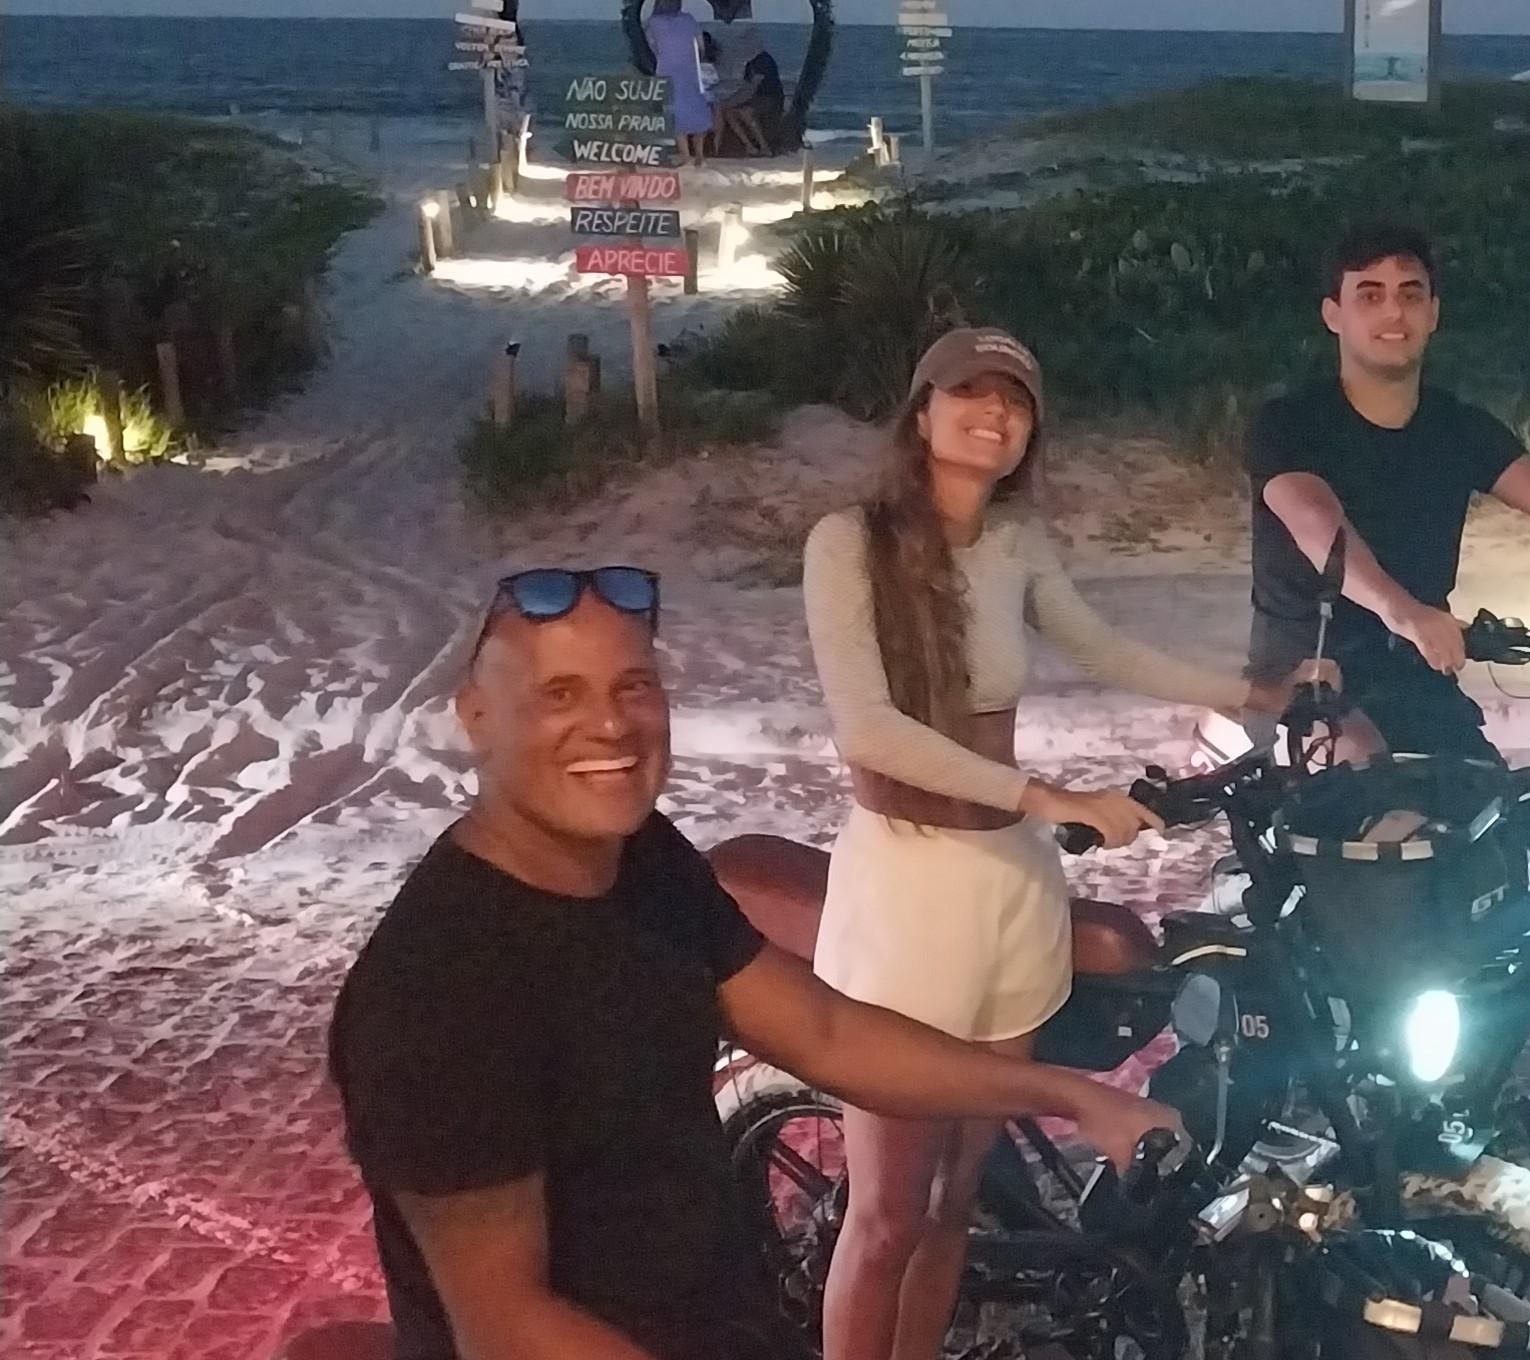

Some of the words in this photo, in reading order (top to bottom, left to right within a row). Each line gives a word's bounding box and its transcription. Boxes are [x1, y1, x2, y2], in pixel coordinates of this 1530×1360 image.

[565, 77, 607, 101] NÃO
[615, 80, 668, 101] SUJE
[565, 112, 614, 129] NOSSA
[573, 139, 663, 165] WELCOME
[574, 175, 616, 200] BEM
[620, 175, 677, 199] VINDO
[575, 210, 674, 235] RESPEITE
[586, 247, 678, 274] APRECIE
[1241, 1013, 1270, 1039] 05
[1437, 1120, 1466, 1144] 05
